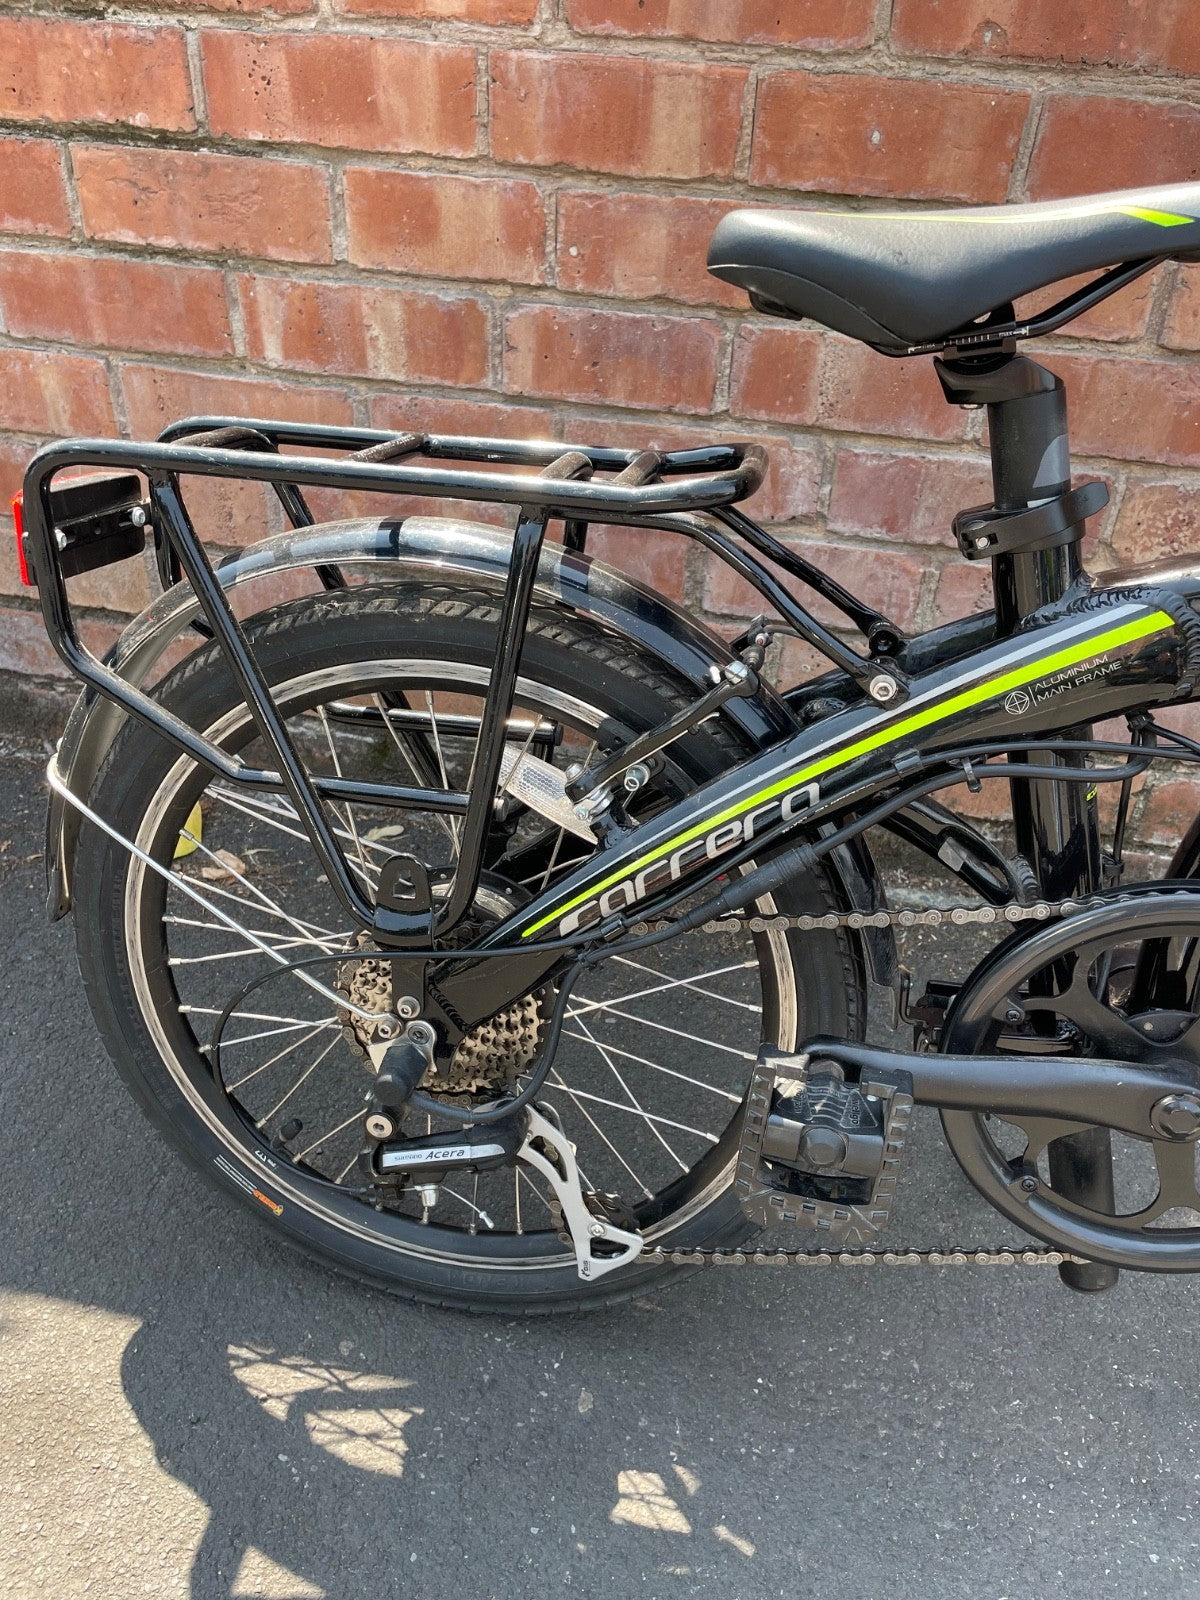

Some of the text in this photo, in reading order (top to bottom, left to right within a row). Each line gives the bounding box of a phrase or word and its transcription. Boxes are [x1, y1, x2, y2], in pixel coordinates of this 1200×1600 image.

[1034, 654, 1109, 692] ALUMINIUM
[1036, 660, 1122, 702] MAIN FRAME
[559, 782, 820, 938] carrera
[426, 1148, 465, 1160] Acera
